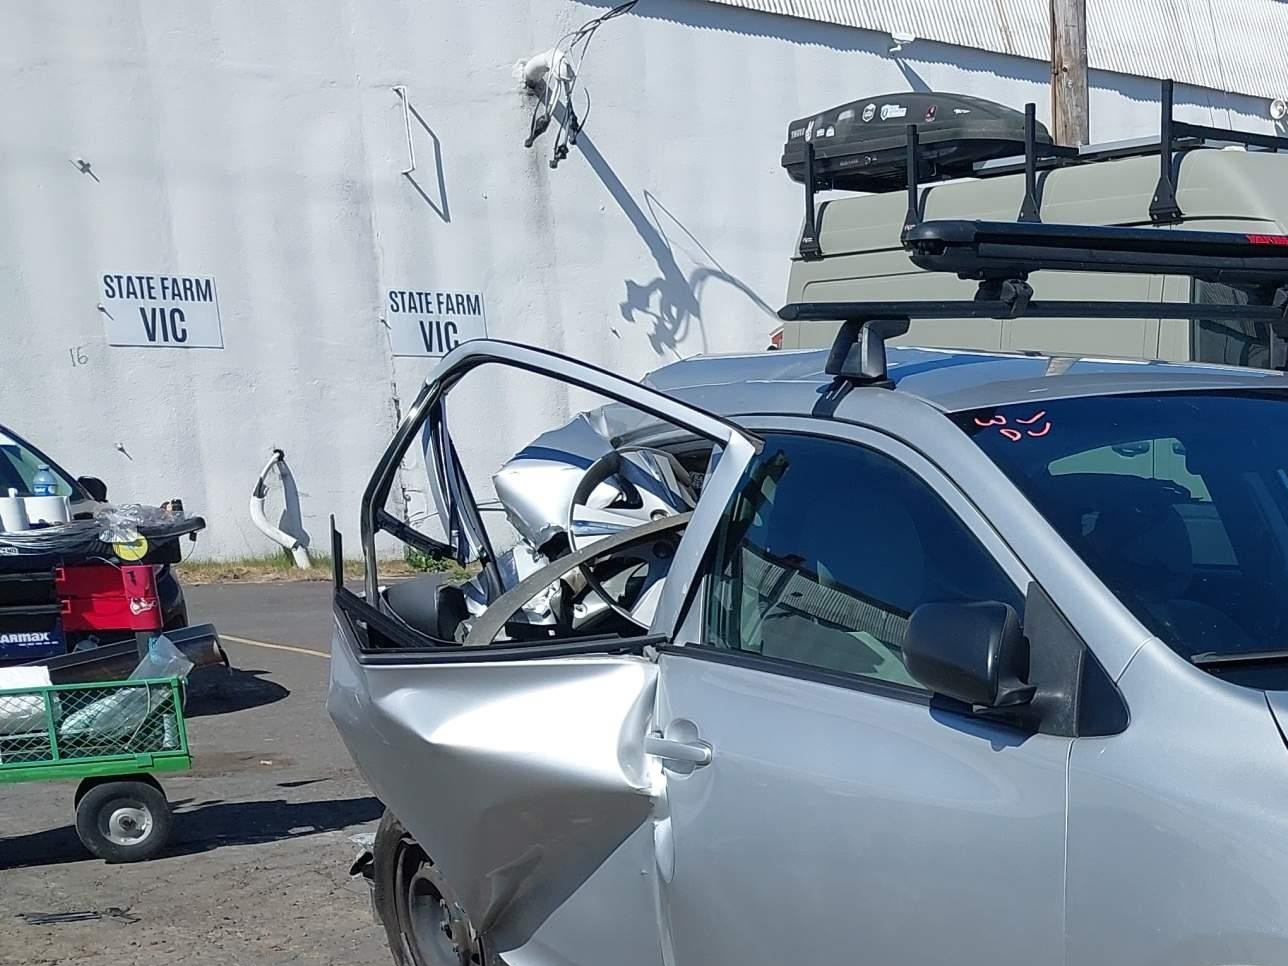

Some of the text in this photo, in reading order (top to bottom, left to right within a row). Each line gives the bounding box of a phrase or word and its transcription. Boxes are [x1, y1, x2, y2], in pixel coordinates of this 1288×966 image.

[103, 274, 213, 302] STATE FARM
[389, 290, 481, 316] STATE FARM
[139, 306, 188, 343] VIC
[419, 320, 459, 352] VIC
[0, 632, 50, 643] ARmax
